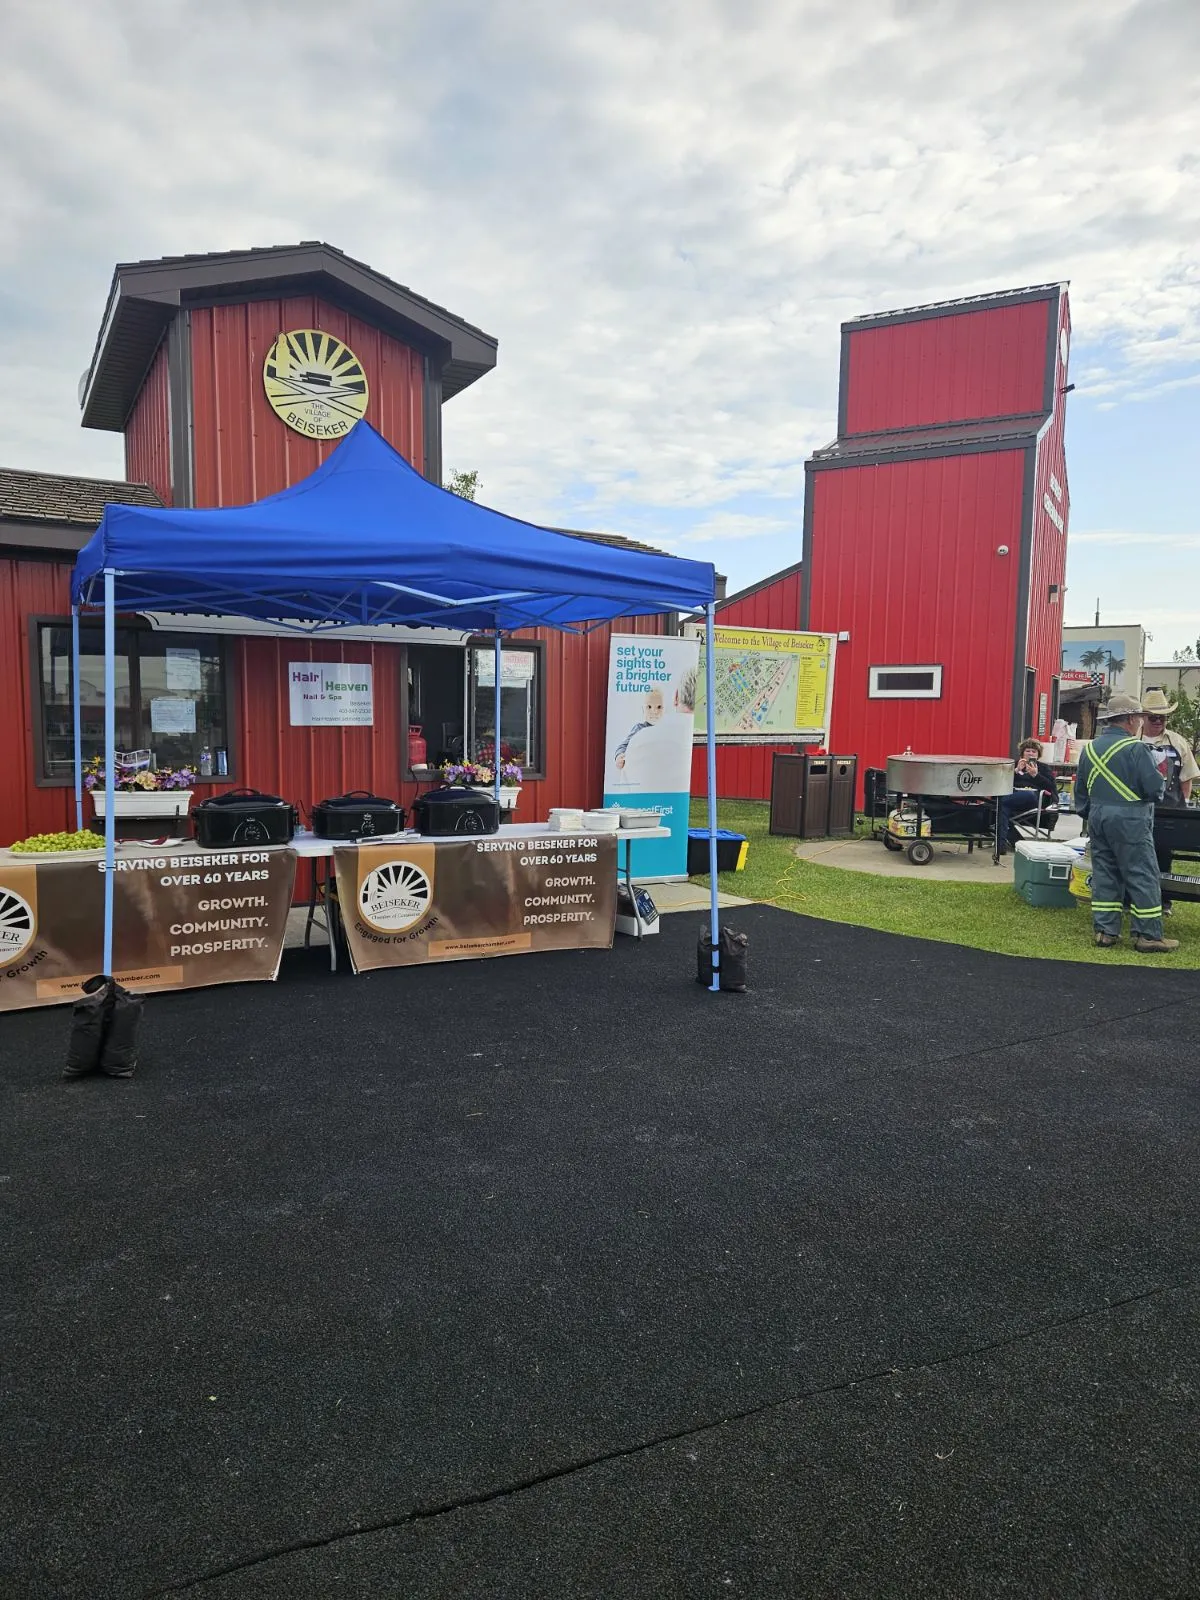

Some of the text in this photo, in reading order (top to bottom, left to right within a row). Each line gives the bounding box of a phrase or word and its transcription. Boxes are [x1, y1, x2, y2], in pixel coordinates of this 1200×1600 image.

[304, 408, 331, 418] VILLAGE
[286, 411, 349, 436] BEISEKER
[713, 632, 814, 651] Welcome to the Village of Beiseker
[617, 645, 663, 658] set your
[616, 657, 666, 670] sights to
[292, 671, 319, 682] Hair
[616, 668, 672, 682] a brighter
[325, 681, 368, 692] Heaven
[616, 680, 654, 692] future.
[963, 776, 984, 784] LUFF
[476, 838, 598, 853] SERVING BEISEKER FOR
[170, 854, 239, 869] BEISEKER
[241, 852, 270, 864] FOR
[520, 853, 598, 866] OVER 60 YEARS
[160, 870, 269, 887] OVER 60 YEARS
[545, 875, 596, 888] GROWTH.
[197, 895, 269, 912] GROWTH.
[371, 899, 421, 912] BEISEKER
[524, 893, 596, 907] COMMUNITY.
[523, 911, 595, 926] PROSPERITY.
[169, 916, 269, 936] COMMUNITY.
[354, 916, 439, 944] Engaged for Growth
[170, 937, 269, 957] PROSPERITY.
[6, 949, 48, 978] Growth
